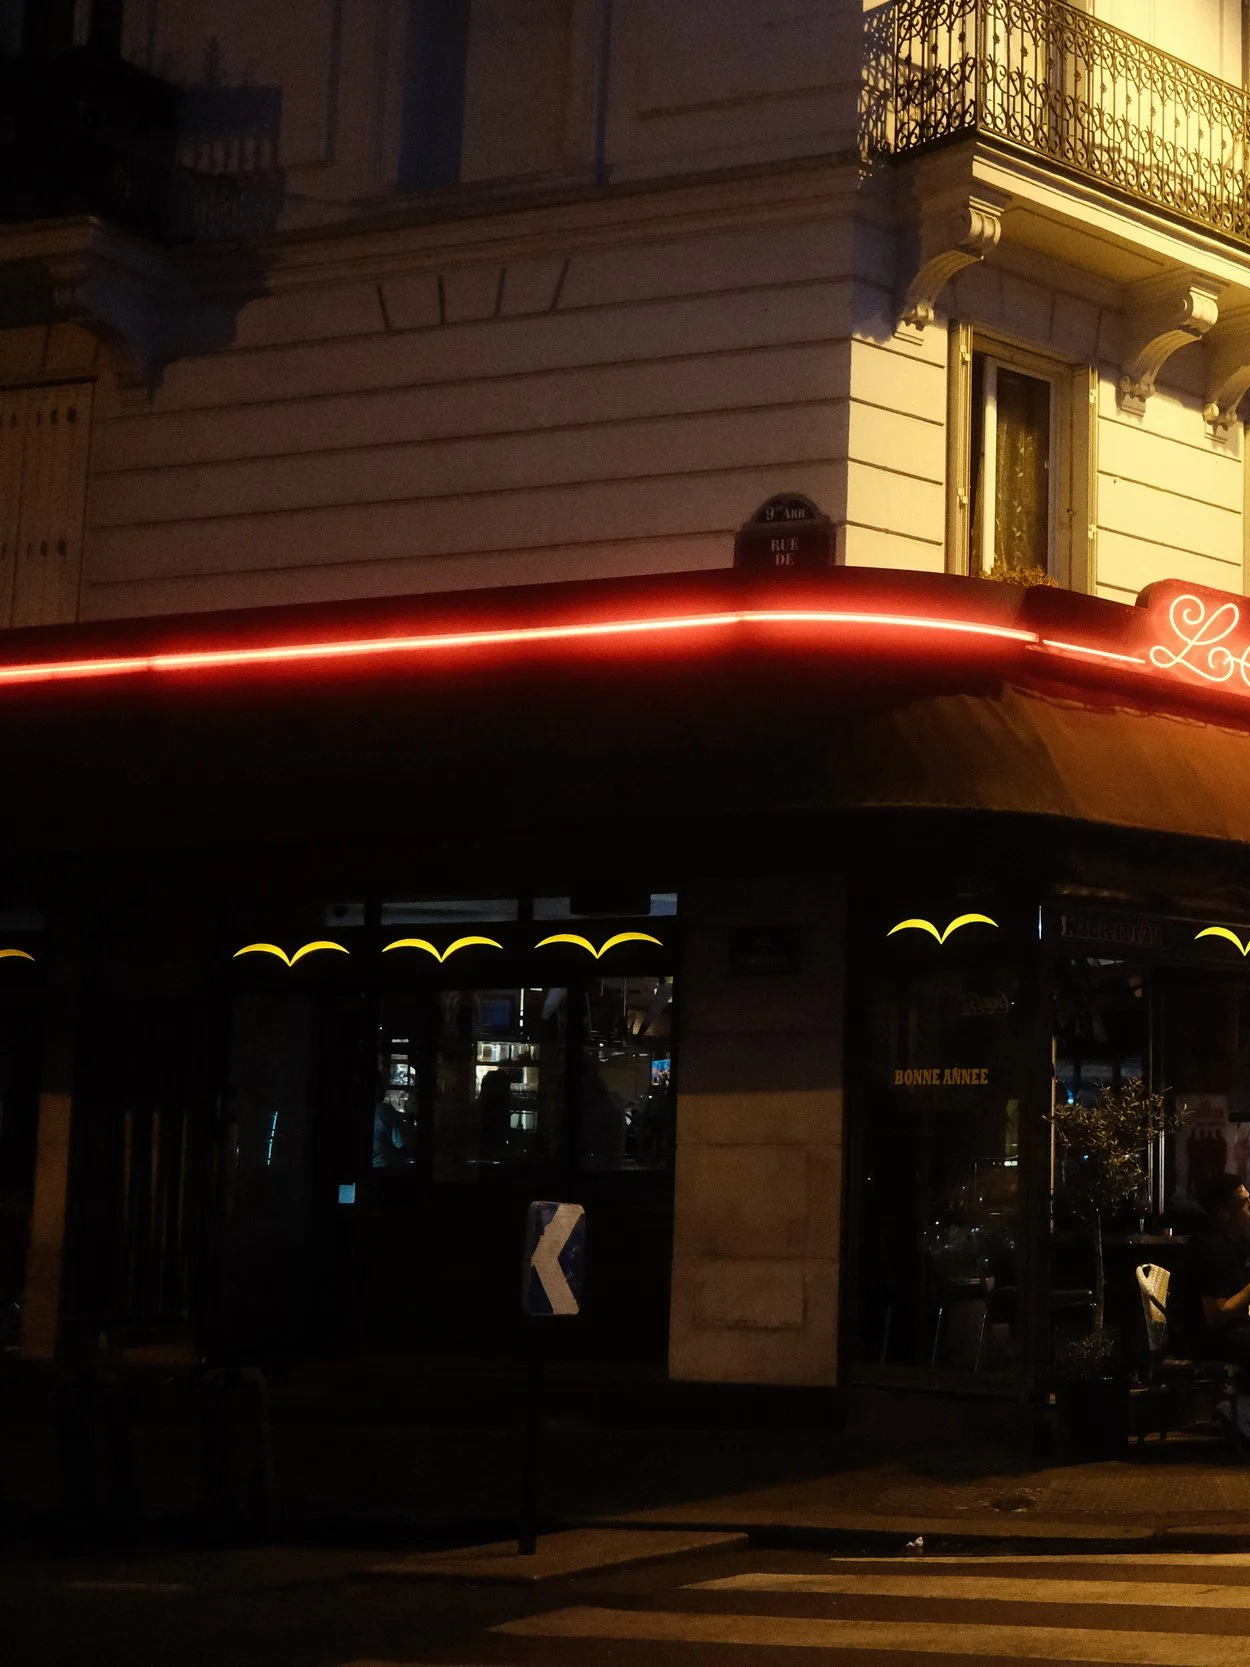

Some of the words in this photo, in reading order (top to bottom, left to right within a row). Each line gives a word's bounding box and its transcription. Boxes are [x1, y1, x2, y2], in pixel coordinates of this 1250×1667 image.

[770, 536, 800, 552] RUE
[775, 553, 795, 566] DE
[894, 1068, 941, 1086] BONNE
